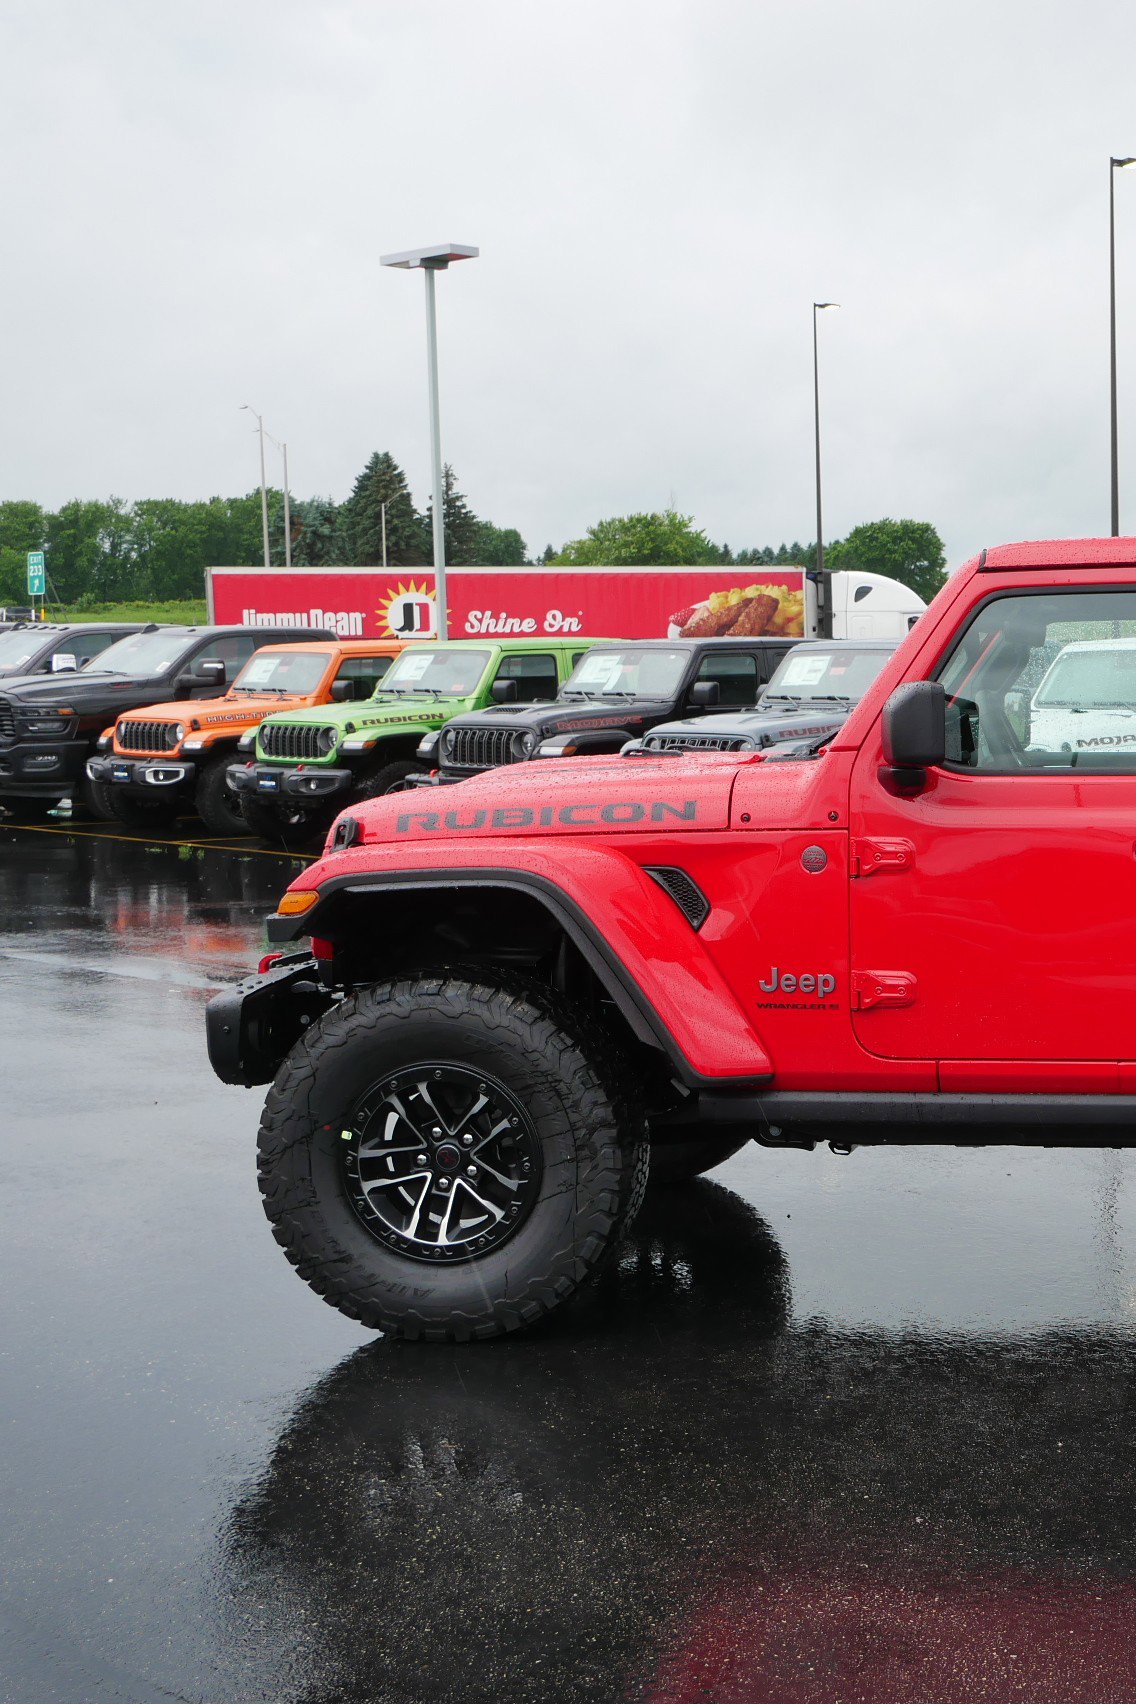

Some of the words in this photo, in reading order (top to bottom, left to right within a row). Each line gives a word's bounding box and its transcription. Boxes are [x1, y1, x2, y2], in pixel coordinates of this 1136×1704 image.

[30, 555, 43, 564] EXIT
[30, 565, 43, 576] 233
[309, 608, 364, 636] Dean
[464, 610, 537, 633] Shine
[543, 609, 582, 632] On
[362, 713, 445, 726] RUBICON
[556, 715, 644, 730] MOJAVE
[396, 800, 698, 833] RUBICON
[759, 966, 836, 998] Jeep
[756, 1002, 827, 1010] WRANGLER
